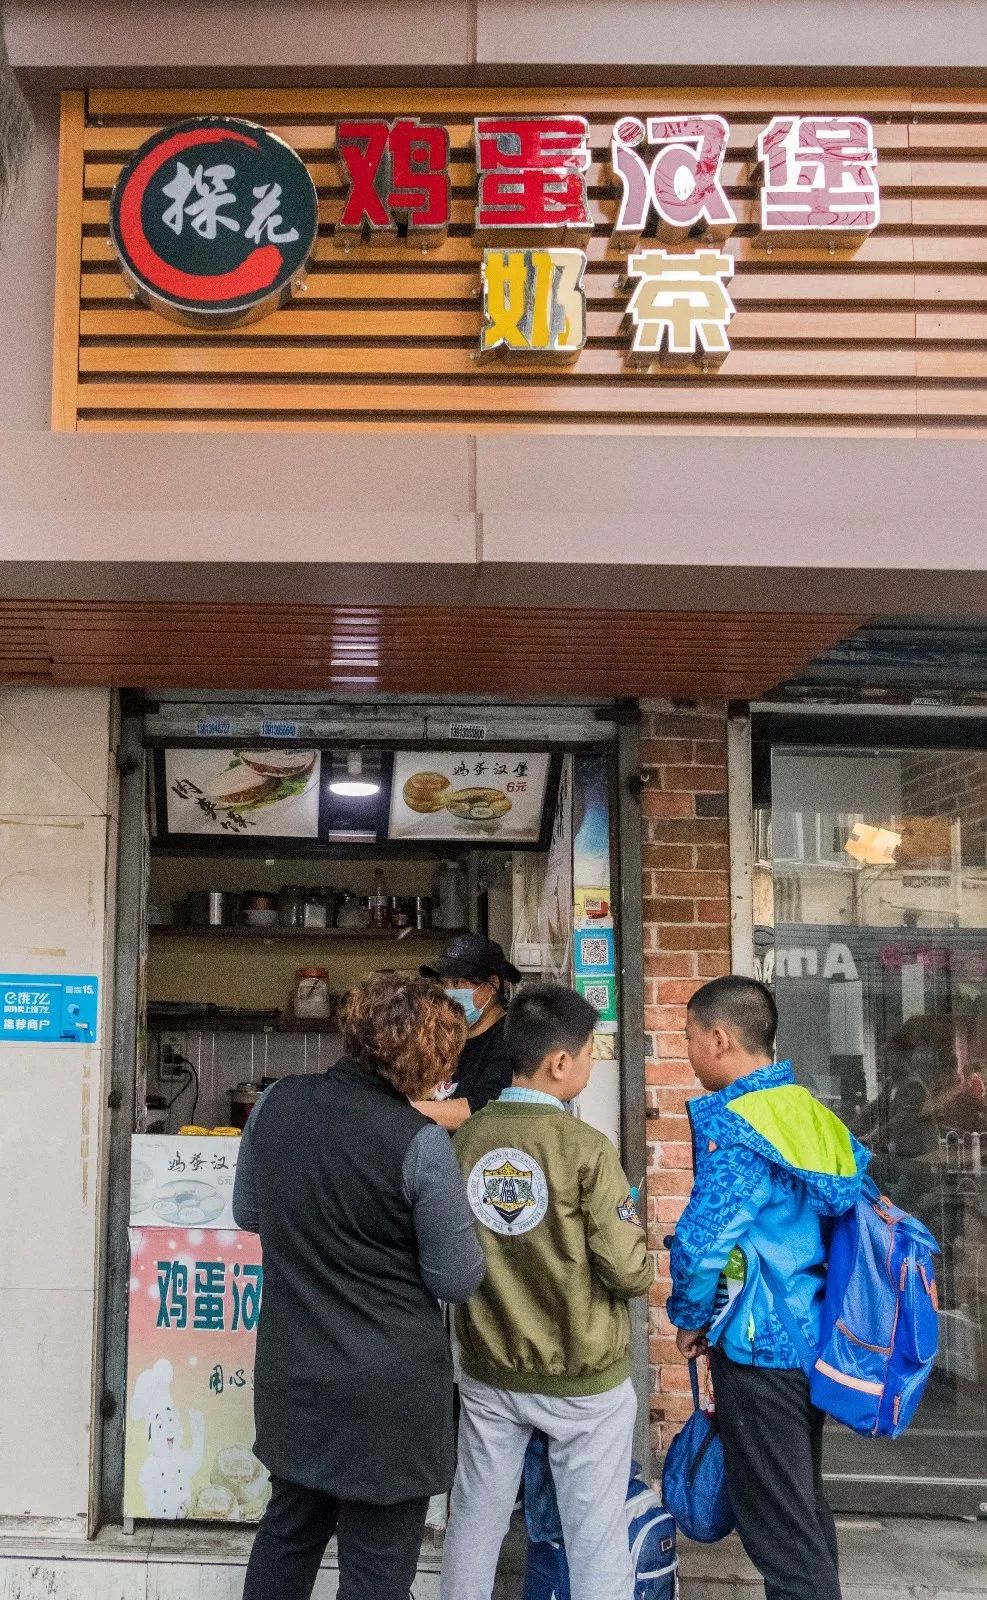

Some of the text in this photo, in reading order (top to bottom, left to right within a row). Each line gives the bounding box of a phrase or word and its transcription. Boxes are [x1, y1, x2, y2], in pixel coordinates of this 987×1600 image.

[335, 114, 881, 231] 鸡蛋汉堡
[161, 161, 299, 244] 探花
[480, 247, 736, 352] 奶茶
[452, 760, 528, 777] 鸡蛋汉堡
[506, 781, 527, 793] 6元
[168, 1150, 237, 1172] 鸡蛋汉
[209, 1364, 254, 1395] 用心
